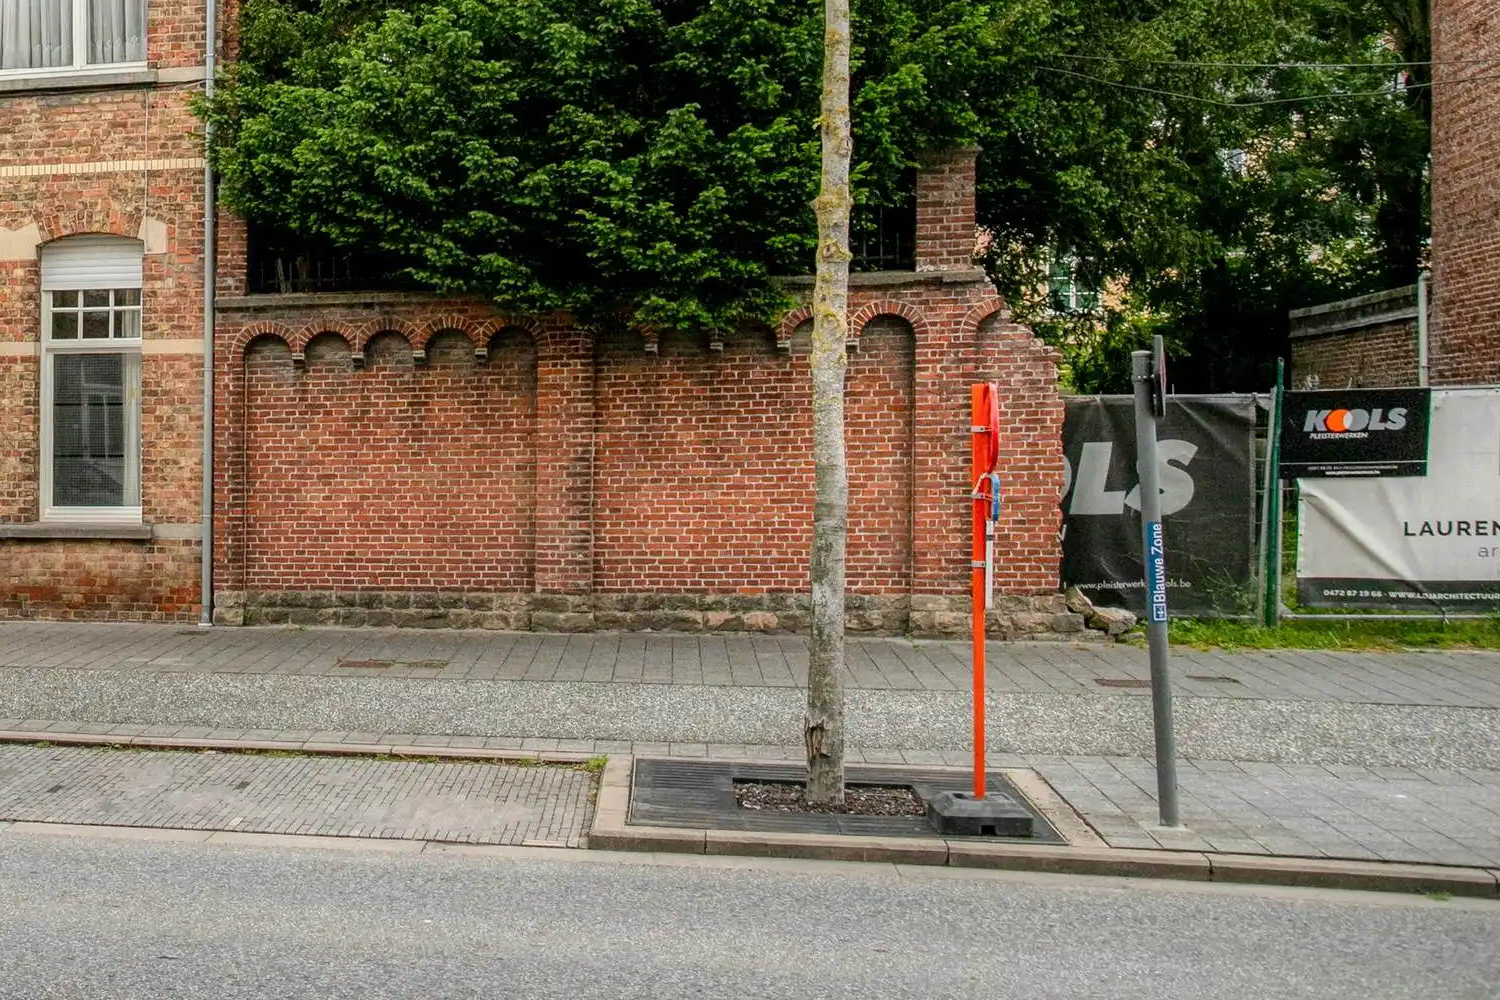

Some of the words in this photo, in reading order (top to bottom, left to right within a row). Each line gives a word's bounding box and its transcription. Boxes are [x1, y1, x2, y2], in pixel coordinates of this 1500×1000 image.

[1303, 407, 1408, 432] KOOLS
[1309, 432, 1369, 440] PLEISTERWERKEN
[1060, 439, 1199, 516] LS
[1151, 523, 1164, 555] Zone
[1153, 558, 1166, 603] Blauwe
